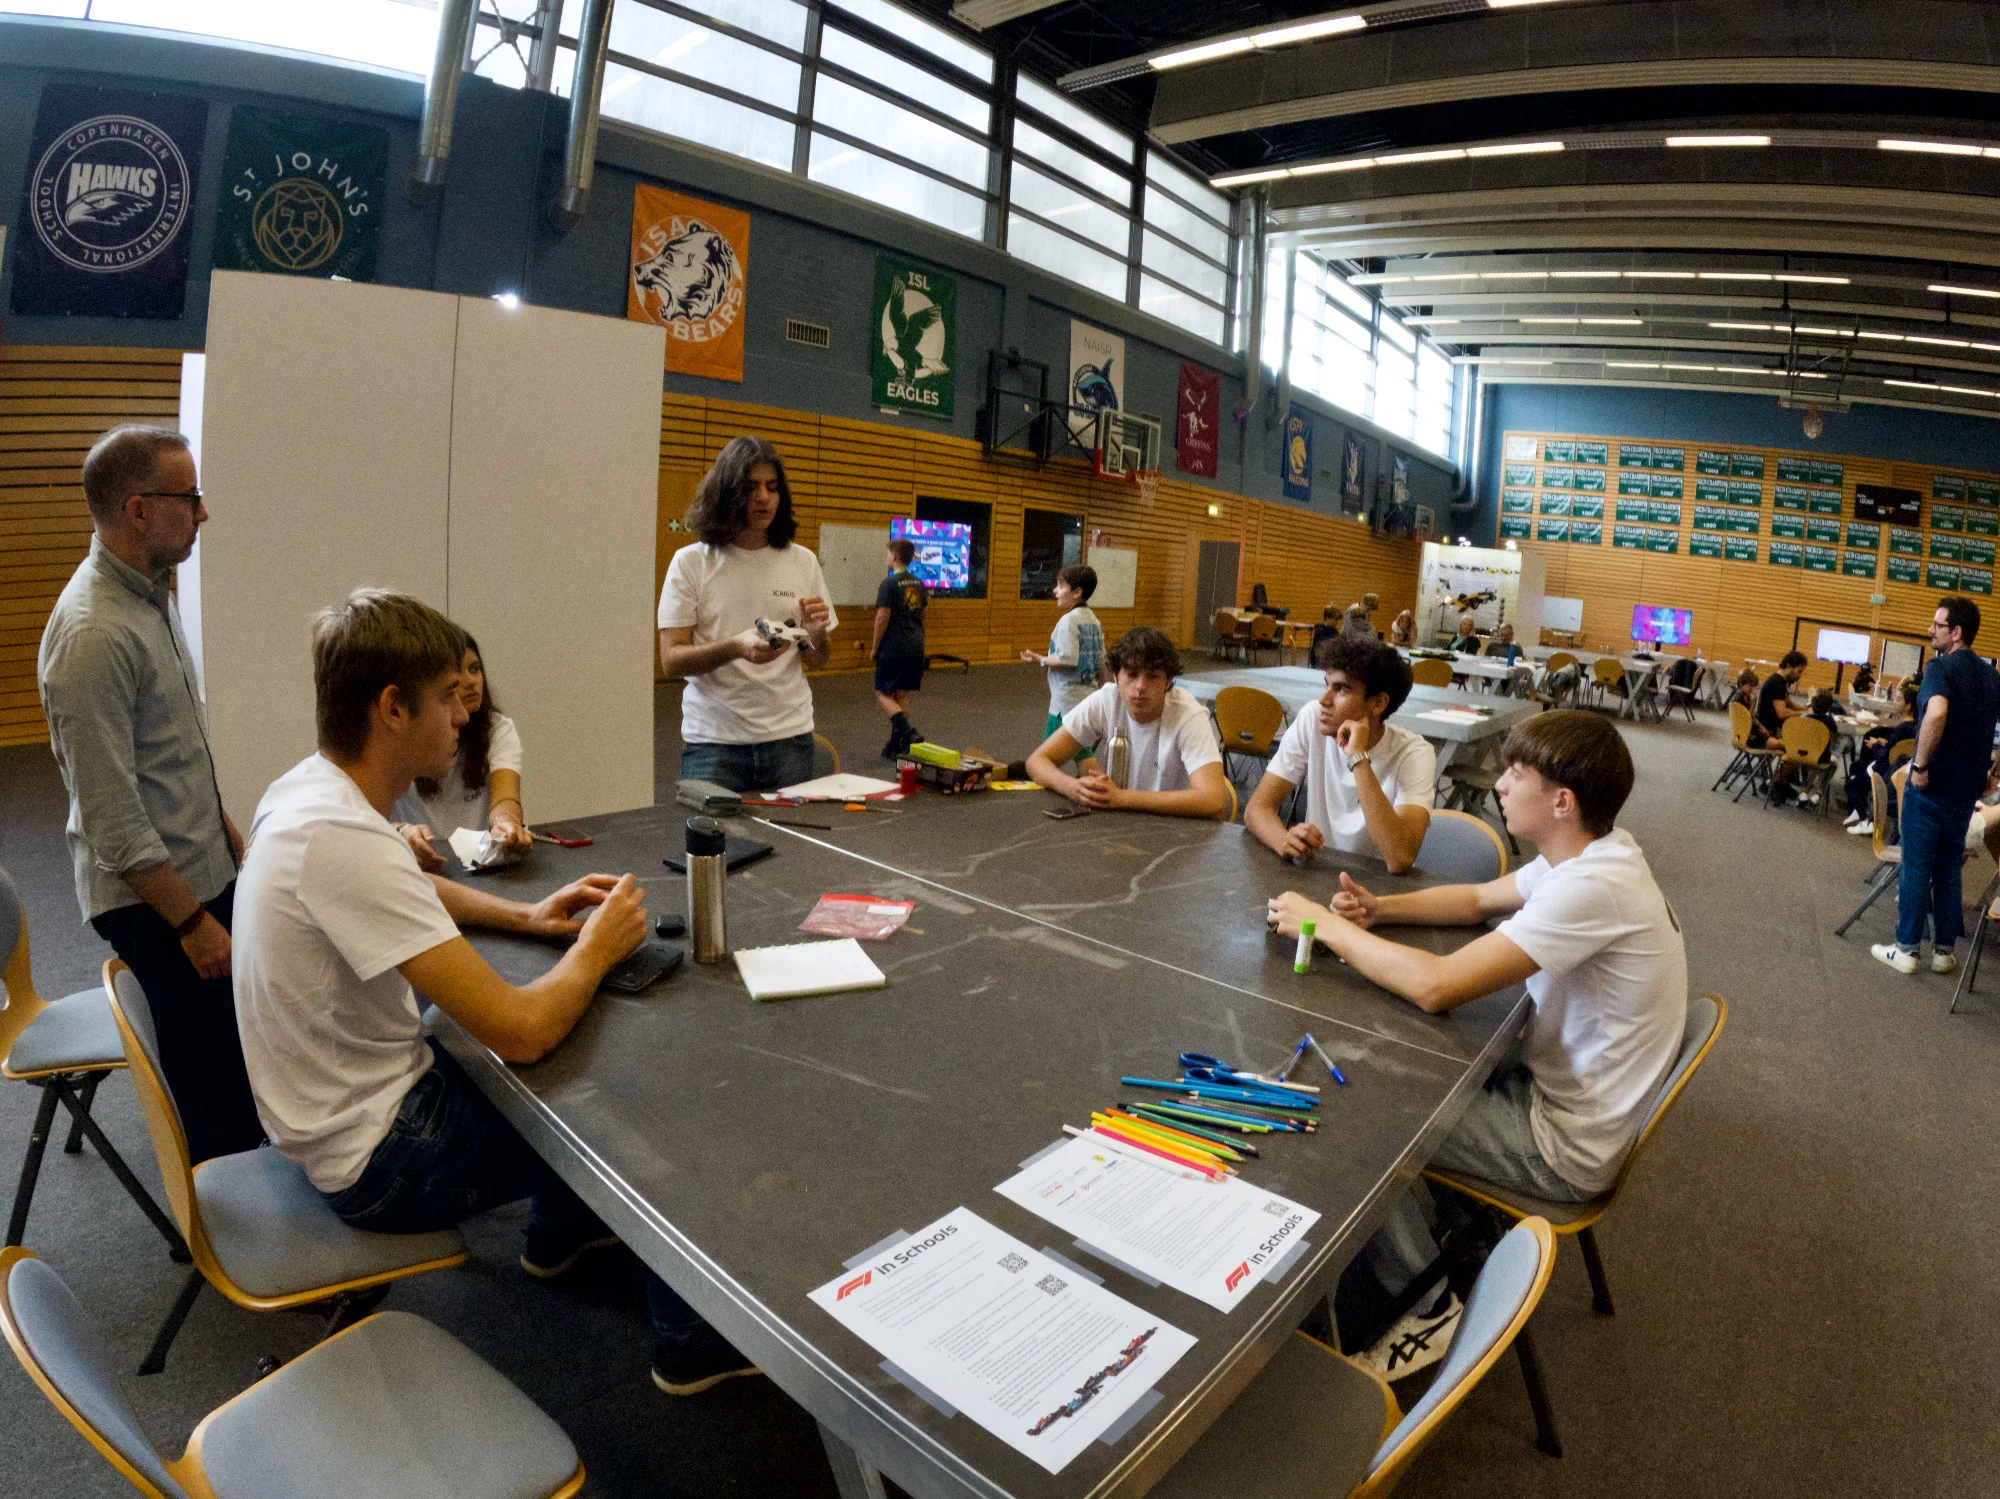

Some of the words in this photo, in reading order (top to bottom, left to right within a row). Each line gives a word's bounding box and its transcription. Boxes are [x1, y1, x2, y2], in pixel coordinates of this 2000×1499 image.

[67, 123, 169, 160] COPENHAGEN
[67, 162, 157, 204] HAWKS
[233, 167, 256, 202] ST
[41, 176, 64, 240] SCHOOL
[83, 183, 180, 263] INTERNATIONAL
[640, 214, 687, 256] ISA
[908, 271, 932, 292] ISL
[673, 285, 745, 343] BEARS
[1083, 336, 1112, 358] NAISR
[886, 382, 940, 407] EAGLES
[773, 590, 795, 598] ICARUS
[875, 1262, 897, 1276] in
[893, 1223, 959, 1265] Schools
[1250, 1243, 1263, 1266] in
[1259, 1213, 1303, 1253] Schools
